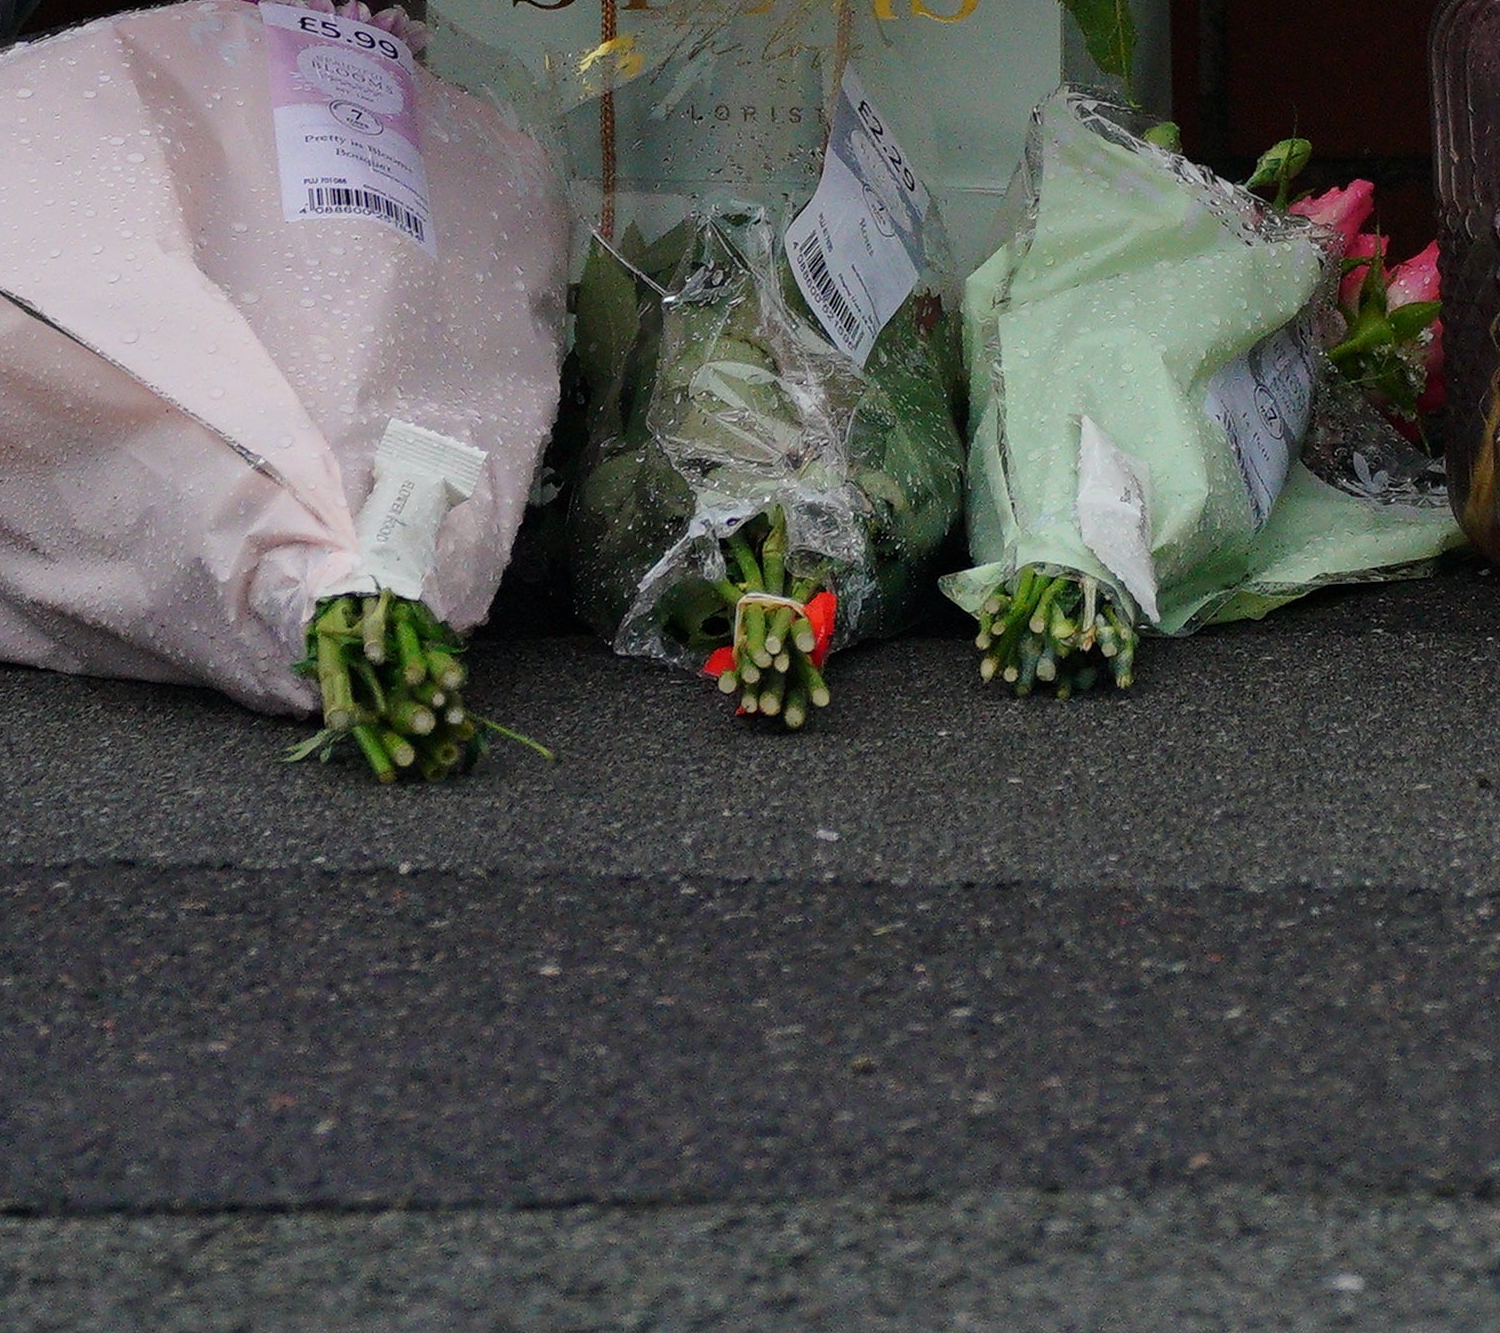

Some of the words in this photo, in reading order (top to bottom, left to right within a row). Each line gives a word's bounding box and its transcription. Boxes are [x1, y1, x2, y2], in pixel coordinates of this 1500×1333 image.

[297, 15, 400, 61] £5.99
[349, 108, 364, 121] 7
[304, 134, 347, 147] Pretty
[856, 99, 916, 193] £2.29
